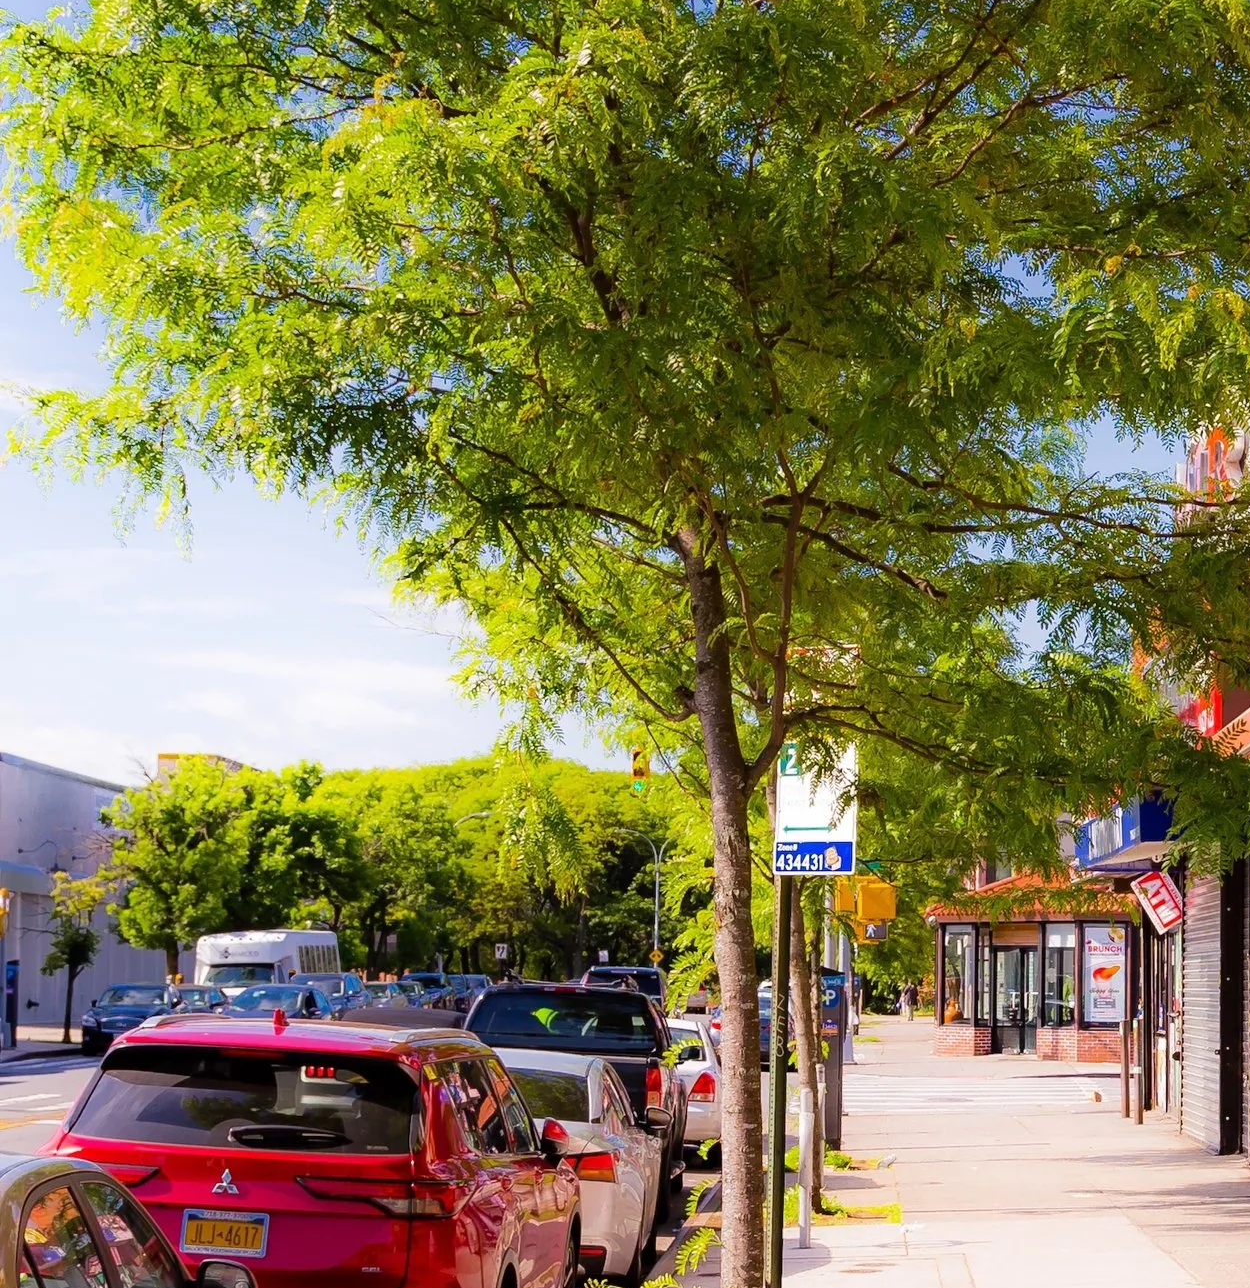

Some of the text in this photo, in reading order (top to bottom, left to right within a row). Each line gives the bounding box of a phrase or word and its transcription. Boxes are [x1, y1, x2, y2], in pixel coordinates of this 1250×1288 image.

[776, 852, 823, 871] 434431
[1087, 944, 1123, 953] BRUNCH
[224, 1225, 259, 1248] 4617
